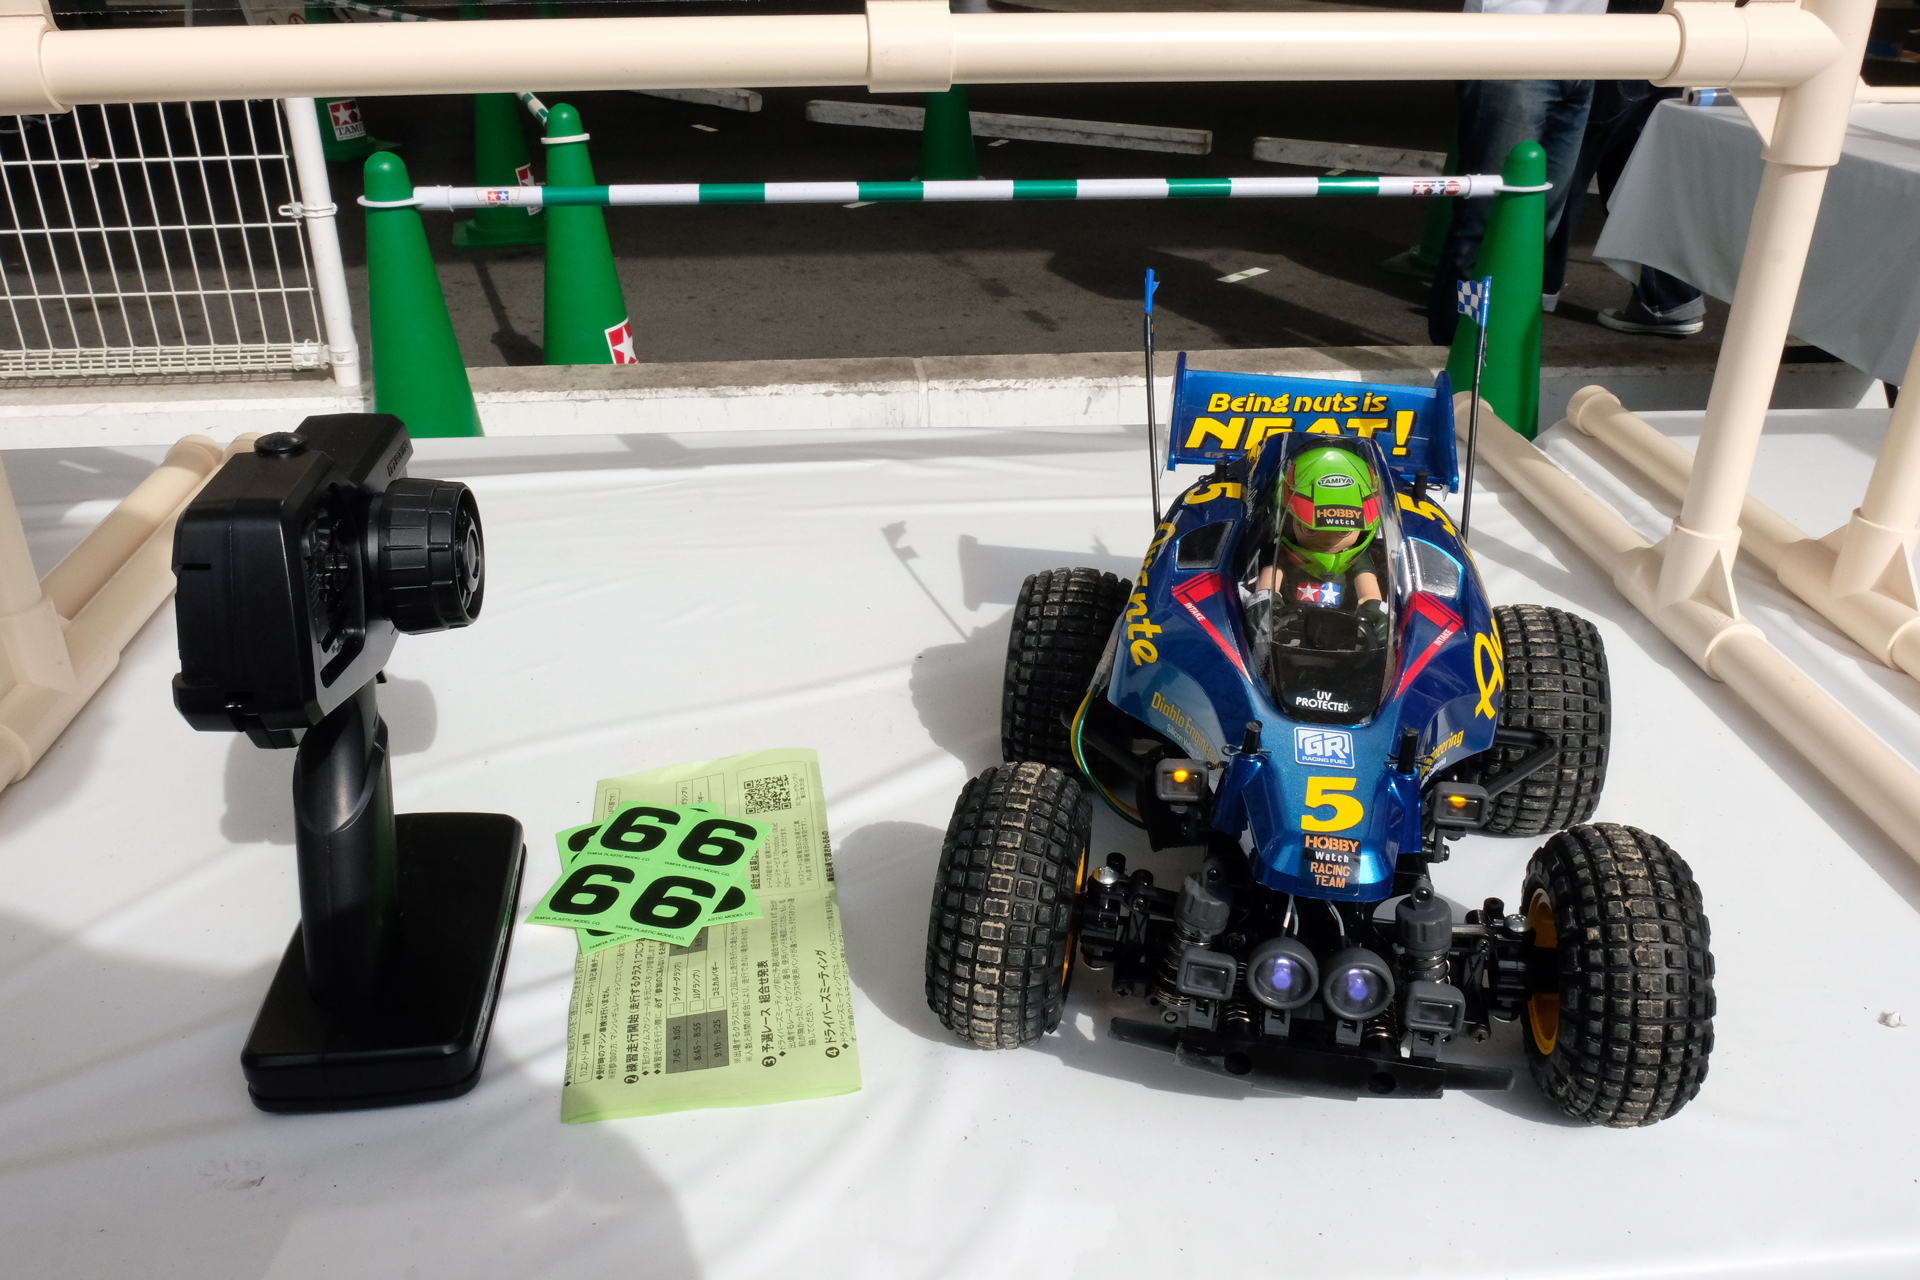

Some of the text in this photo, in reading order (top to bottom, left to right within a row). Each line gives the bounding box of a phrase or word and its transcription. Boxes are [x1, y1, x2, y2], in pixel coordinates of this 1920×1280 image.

[1207, 392, 1388, 414] Being nuts is
[1319, 478, 1353, 486] TAMIYA
[1184, 482, 1242, 505] 5
[1316, 508, 1362, 520] HOBBY
[1326, 518, 1355, 526] Watch
[1397, 492, 1456, 537] 5
[1184, 602, 1207, 622] INTAKE
[1433, 628, 1454, 647] INTAKE
[1296, 696, 1350, 713] PROTECTED
[1316, 690, 1332, 701] UV
[1151, 691, 1186, 728] Diablo
[1166, 723, 1184, 743] Silicon
[1303, 733, 1347, 759] GR
[1302, 755, 1348, 766] RACING FUEL
[1301, 776, 1364, 832] 5
[600, 806, 681, 852] 6
[677, 818, 757, 867] 6
[1305, 835, 1359, 853] HOBBY
[1315, 850, 1349, 863] Watch
[681, 863, 703, 872] PLASTIC
[703, 868, 721, 876] MODEL
[1310, 861, 1351, 877] RACING
[549, 864, 635, 916] 6
[1315, 874, 1346, 889] TEAM
[630, 875, 716, 929] 6
[573, 918, 590, 926] MODEL
[724, 912, 744, 920] MODEL
[633, 927, 656, 936] PLASTIC
[656, 931, 675, 940] MODEL
[755, 958, 771, 1005] 組合せ発表
[814, 948, 837, 1043] ドライバーズミーティング
[672, 1024, 680, 1040] 8:05
[692, 1021, 701, 1037] 8:55
[711, 1018, 720, 1034] 9:25
[759, 1006, 774, 1054] 予選レース
